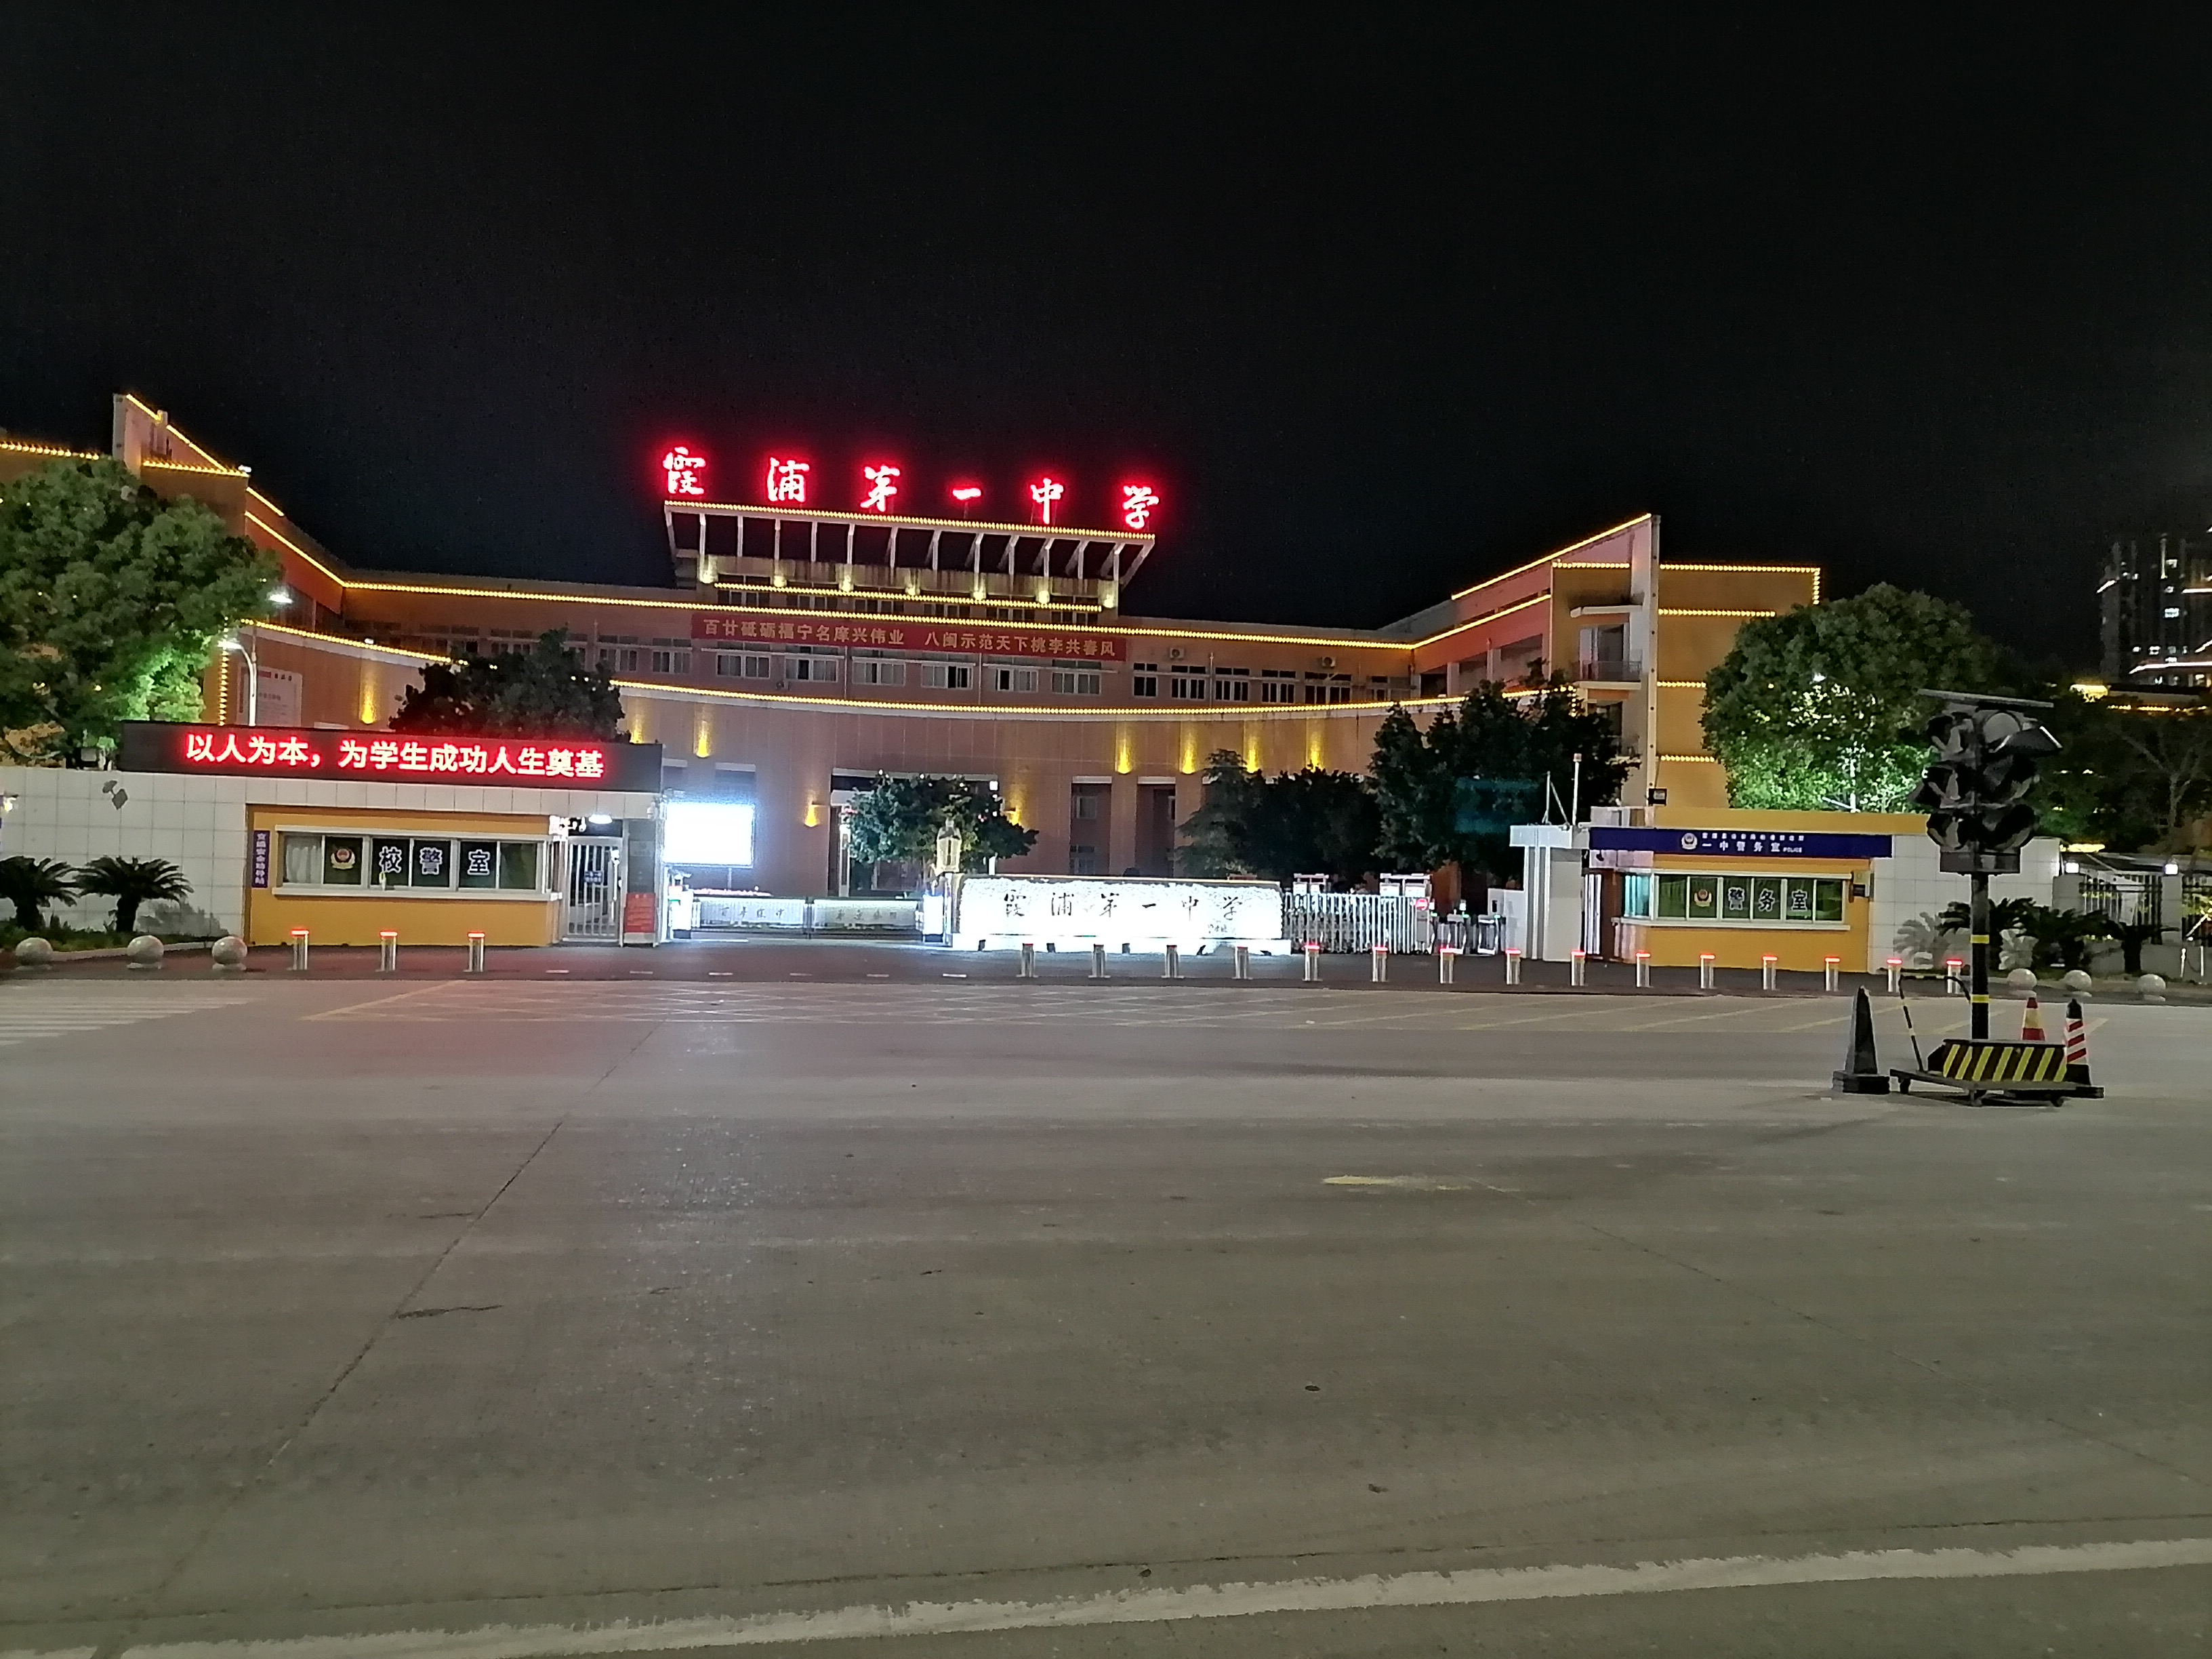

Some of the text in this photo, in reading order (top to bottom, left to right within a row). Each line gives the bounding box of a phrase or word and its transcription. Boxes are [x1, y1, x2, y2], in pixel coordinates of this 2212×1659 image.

[662, 447, 1160, 529] 霞浦第一中学
[924, 632, 1116, 656] 八闽示范天下桃李共春风
[186, 733, 603, 778] 以人为本，为学生成功人生奠基
[380, 847, 491, 877] 校警室
[1004, 889, 1242, 920] 霞浦第一中学
[1727, 887, 1808, 912] 警务室
